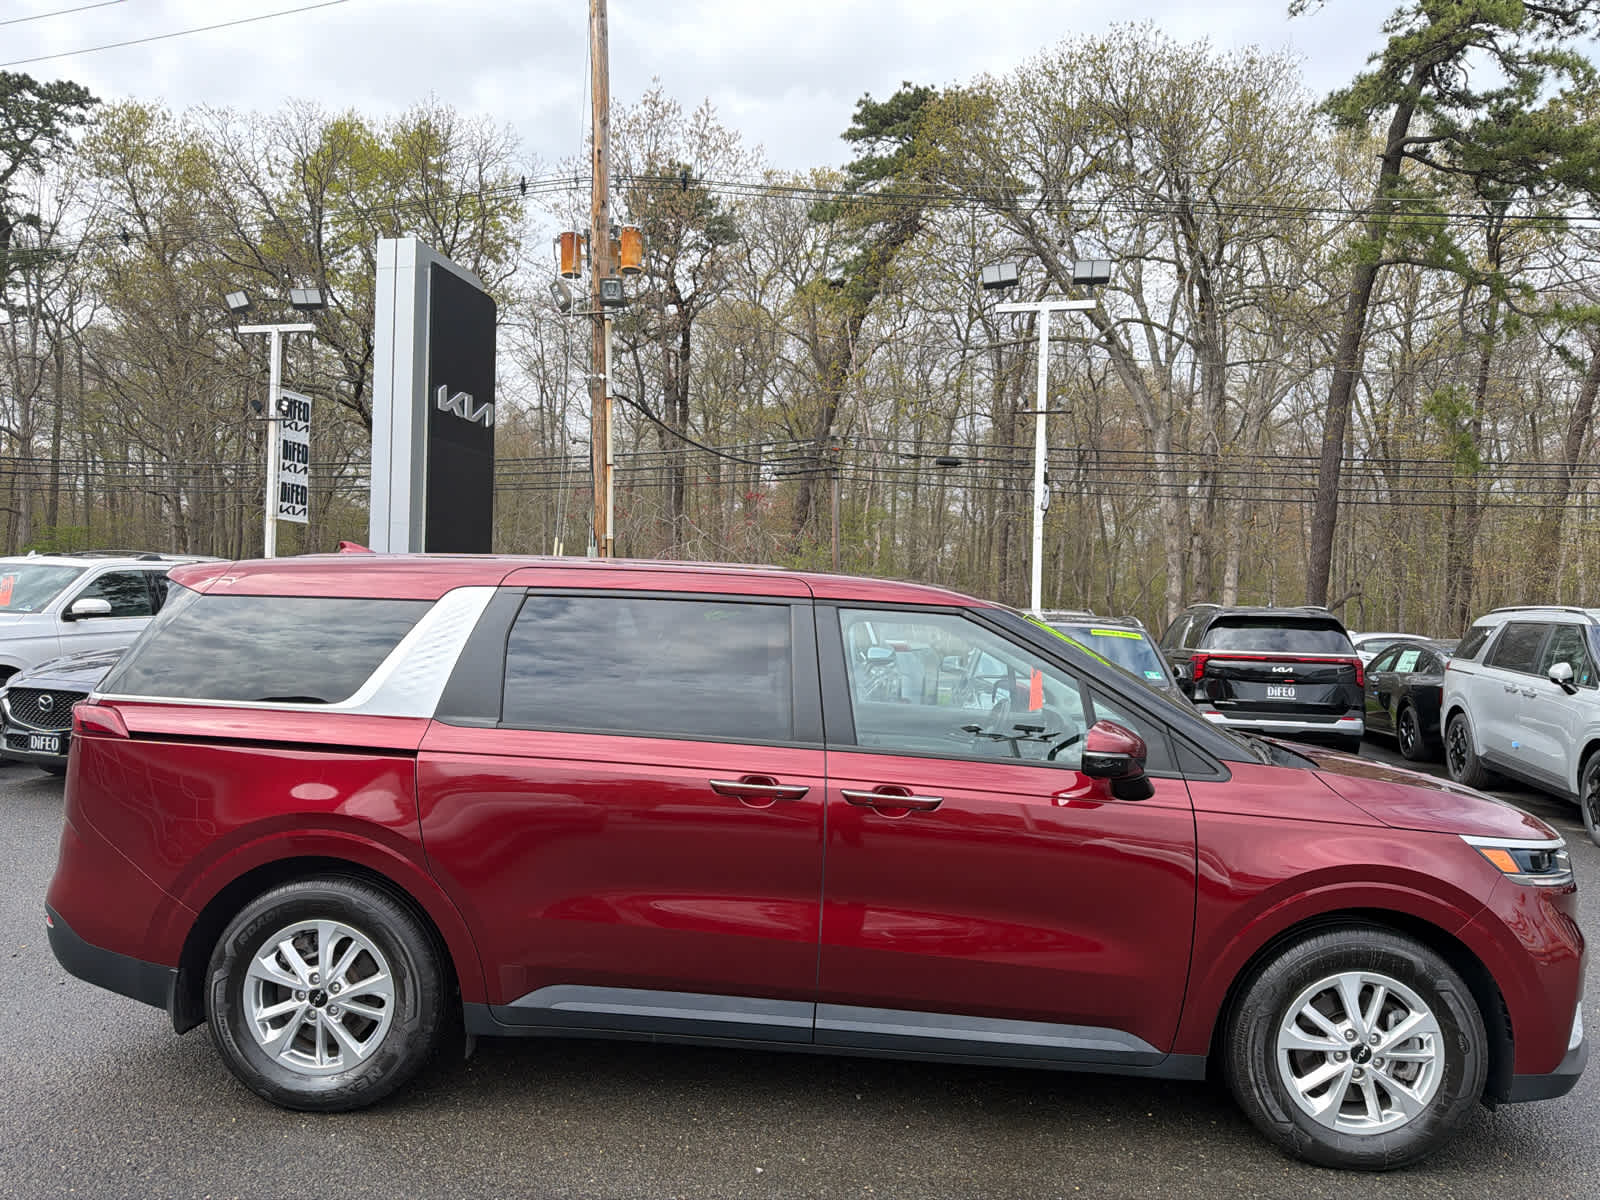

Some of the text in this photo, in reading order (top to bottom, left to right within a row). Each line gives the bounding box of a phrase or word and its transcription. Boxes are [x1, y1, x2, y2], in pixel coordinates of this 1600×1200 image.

[437, 384, 494, 428] KIA
[282, 420, 309, 432] KIA
[282, 439, 309, 464] DiFEO
[281, 462, 308, 475] KIA
[280, 481, 308, 506] DiFEO
[279, 504, 307, 517] KIA
[1266, 686, 1296, 697] DiFEO
[30, 735, 59, 751] DiFEO
